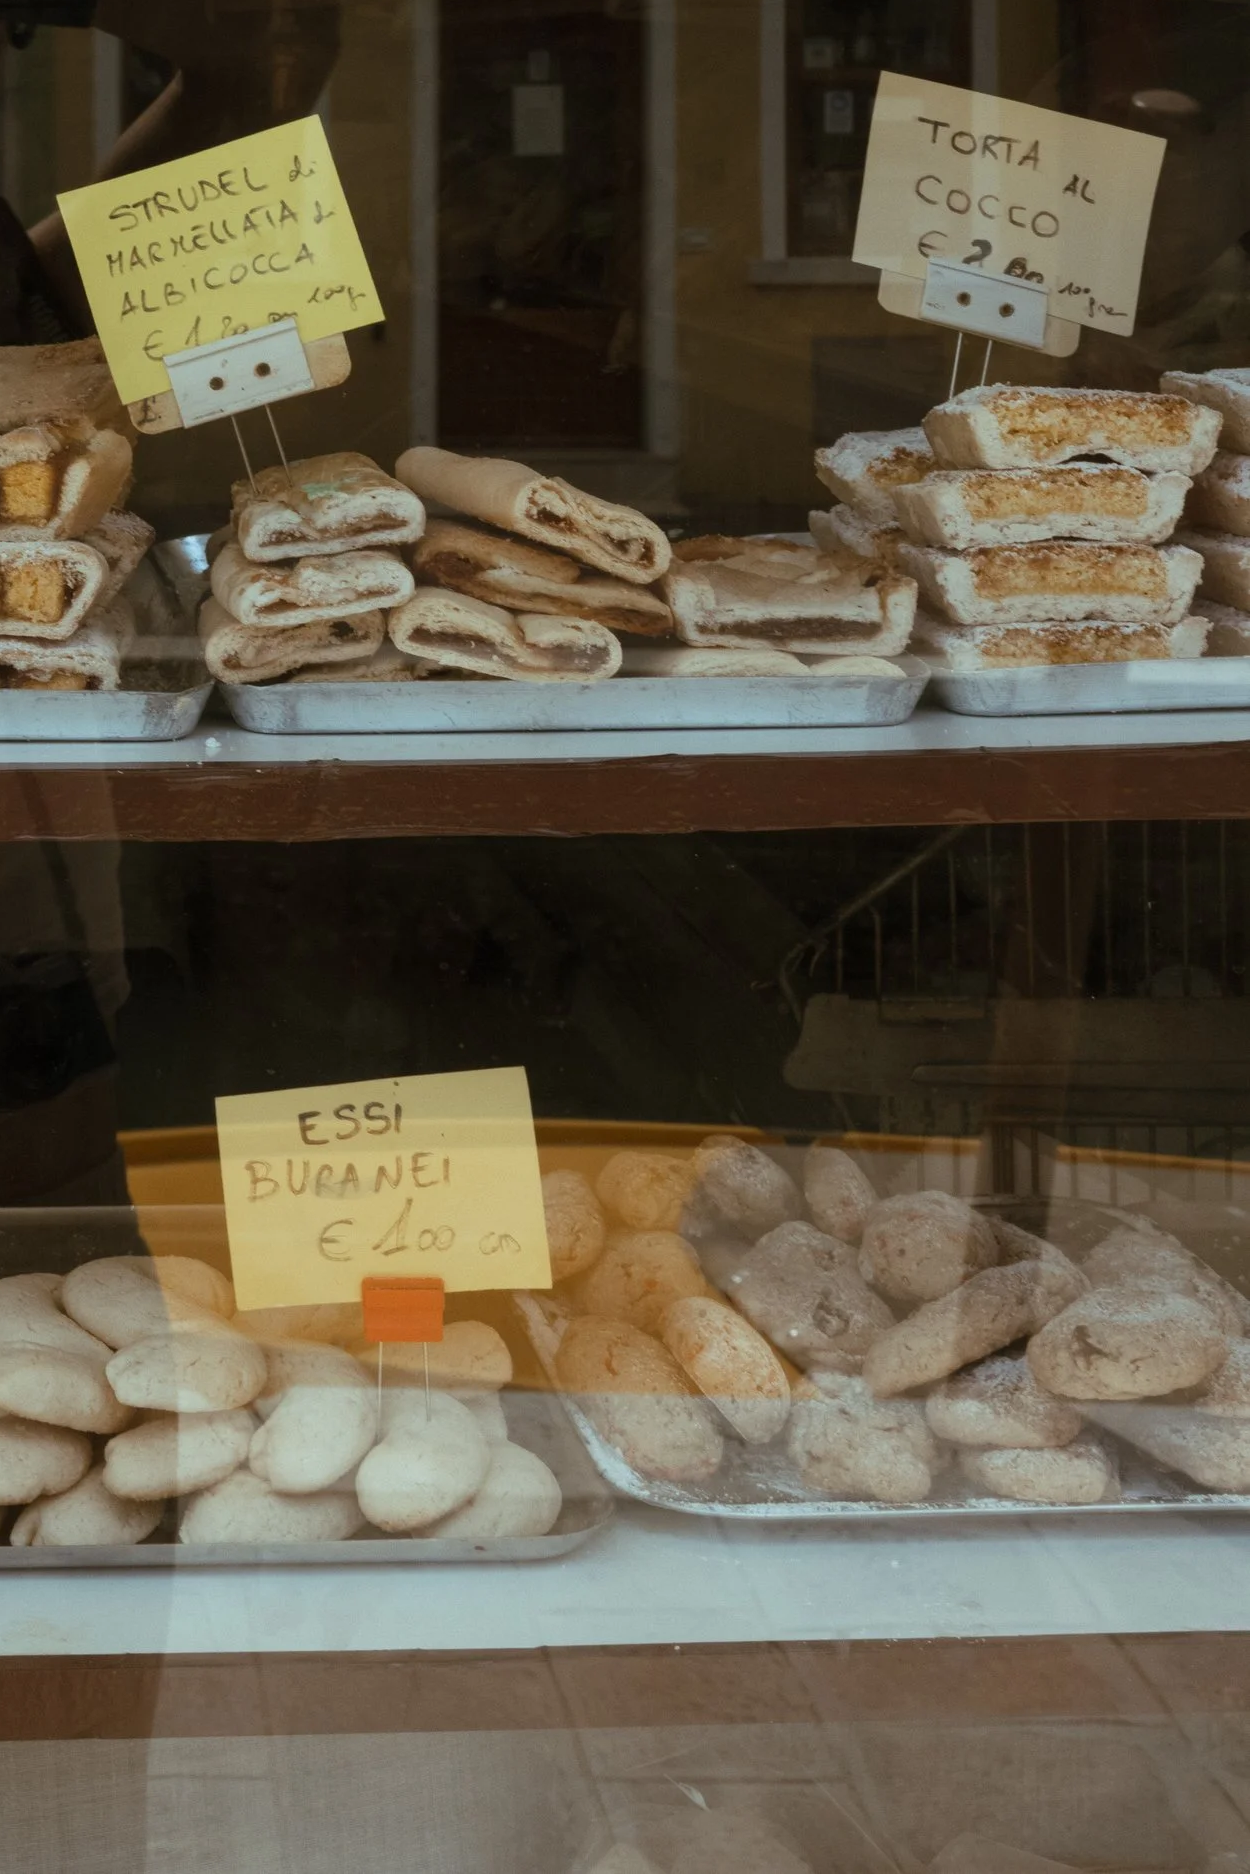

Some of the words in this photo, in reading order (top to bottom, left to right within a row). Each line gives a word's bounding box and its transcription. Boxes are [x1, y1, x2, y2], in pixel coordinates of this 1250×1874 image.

[917, 116, 1040, 171] TORTA
[1062, 174, 1095, 204] AL
[108, 167, 268, 232] STRUDEL
[915, 175, 1060, 238] COCCO
[120, 242, 314, 321] ALBICOCCA
[297, 1099, 403, 1146] ESSI
